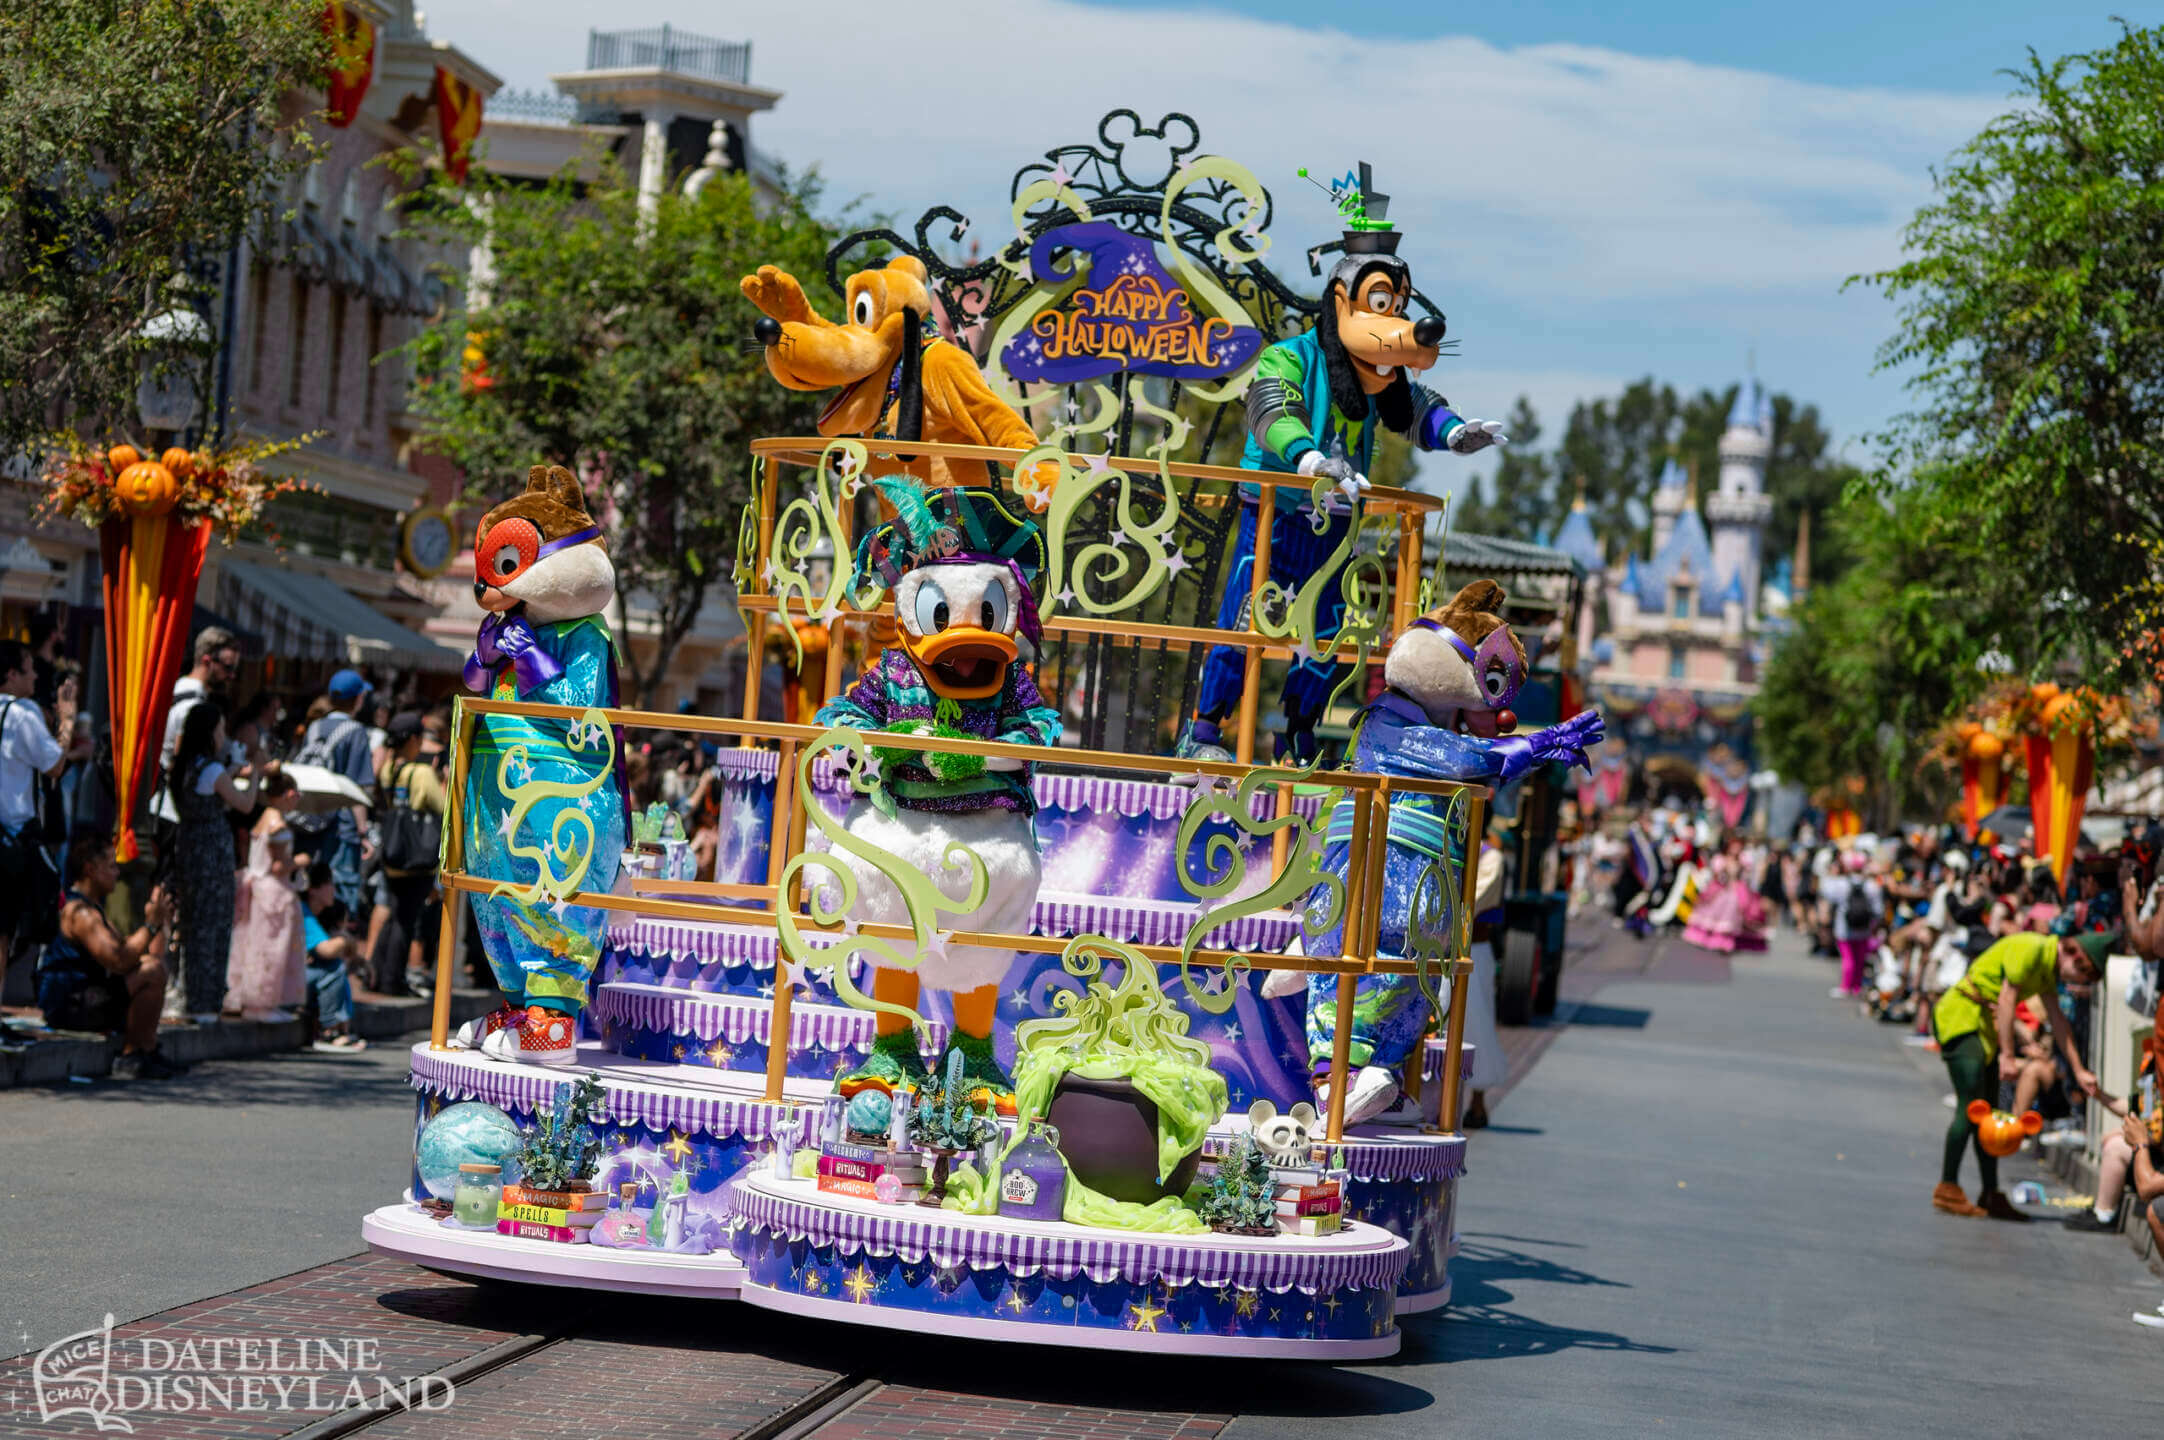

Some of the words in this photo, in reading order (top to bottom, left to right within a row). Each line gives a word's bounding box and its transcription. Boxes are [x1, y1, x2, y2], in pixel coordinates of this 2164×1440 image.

[1073, 275, 1189, 320] HAPPY
[1033, 309, 1233, 367] HALLOWEEN
[836, 1162, 866, 1178] RITUALS
[833, 1181, 861, 1195] MAGIC
[1007, 1188, 1026, 1197] BREW
[524, 1193, 559, 1206] MAGIC
[513, 1207, 549, 1222] SPELLS
[520, 1225, 549, 1238] RITUALS
